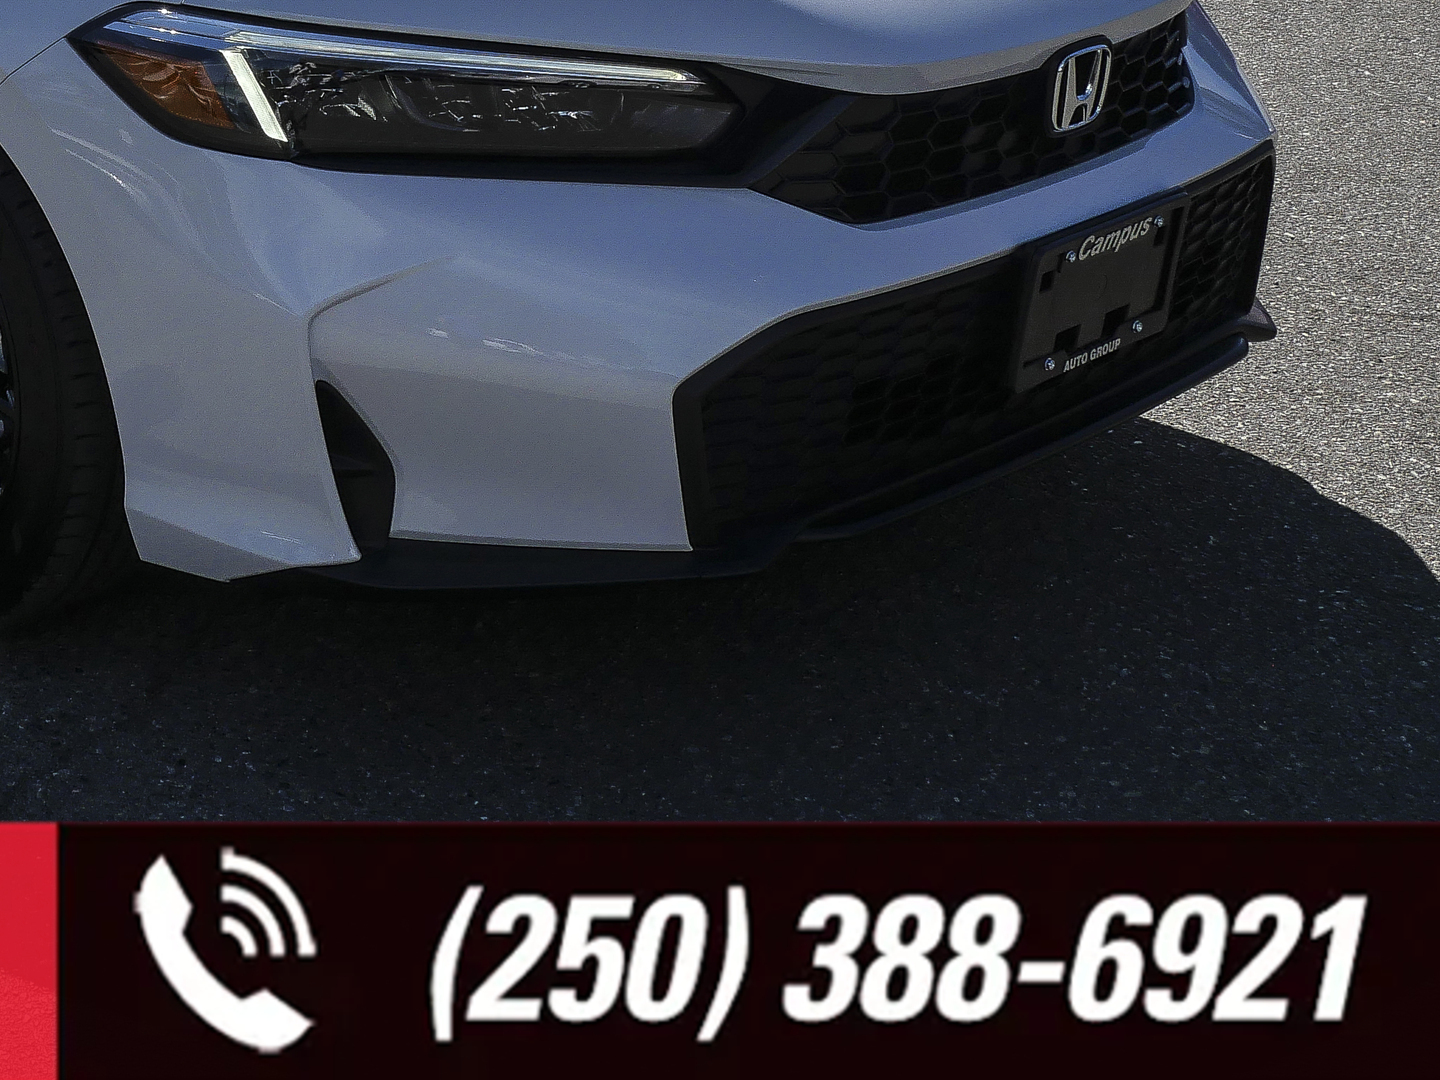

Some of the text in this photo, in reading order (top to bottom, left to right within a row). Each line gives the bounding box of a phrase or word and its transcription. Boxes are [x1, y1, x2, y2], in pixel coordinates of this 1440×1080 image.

[1077, 217, 1153, 261] Campus
[1063, 337, 1122, 373] AUTO GROUP
